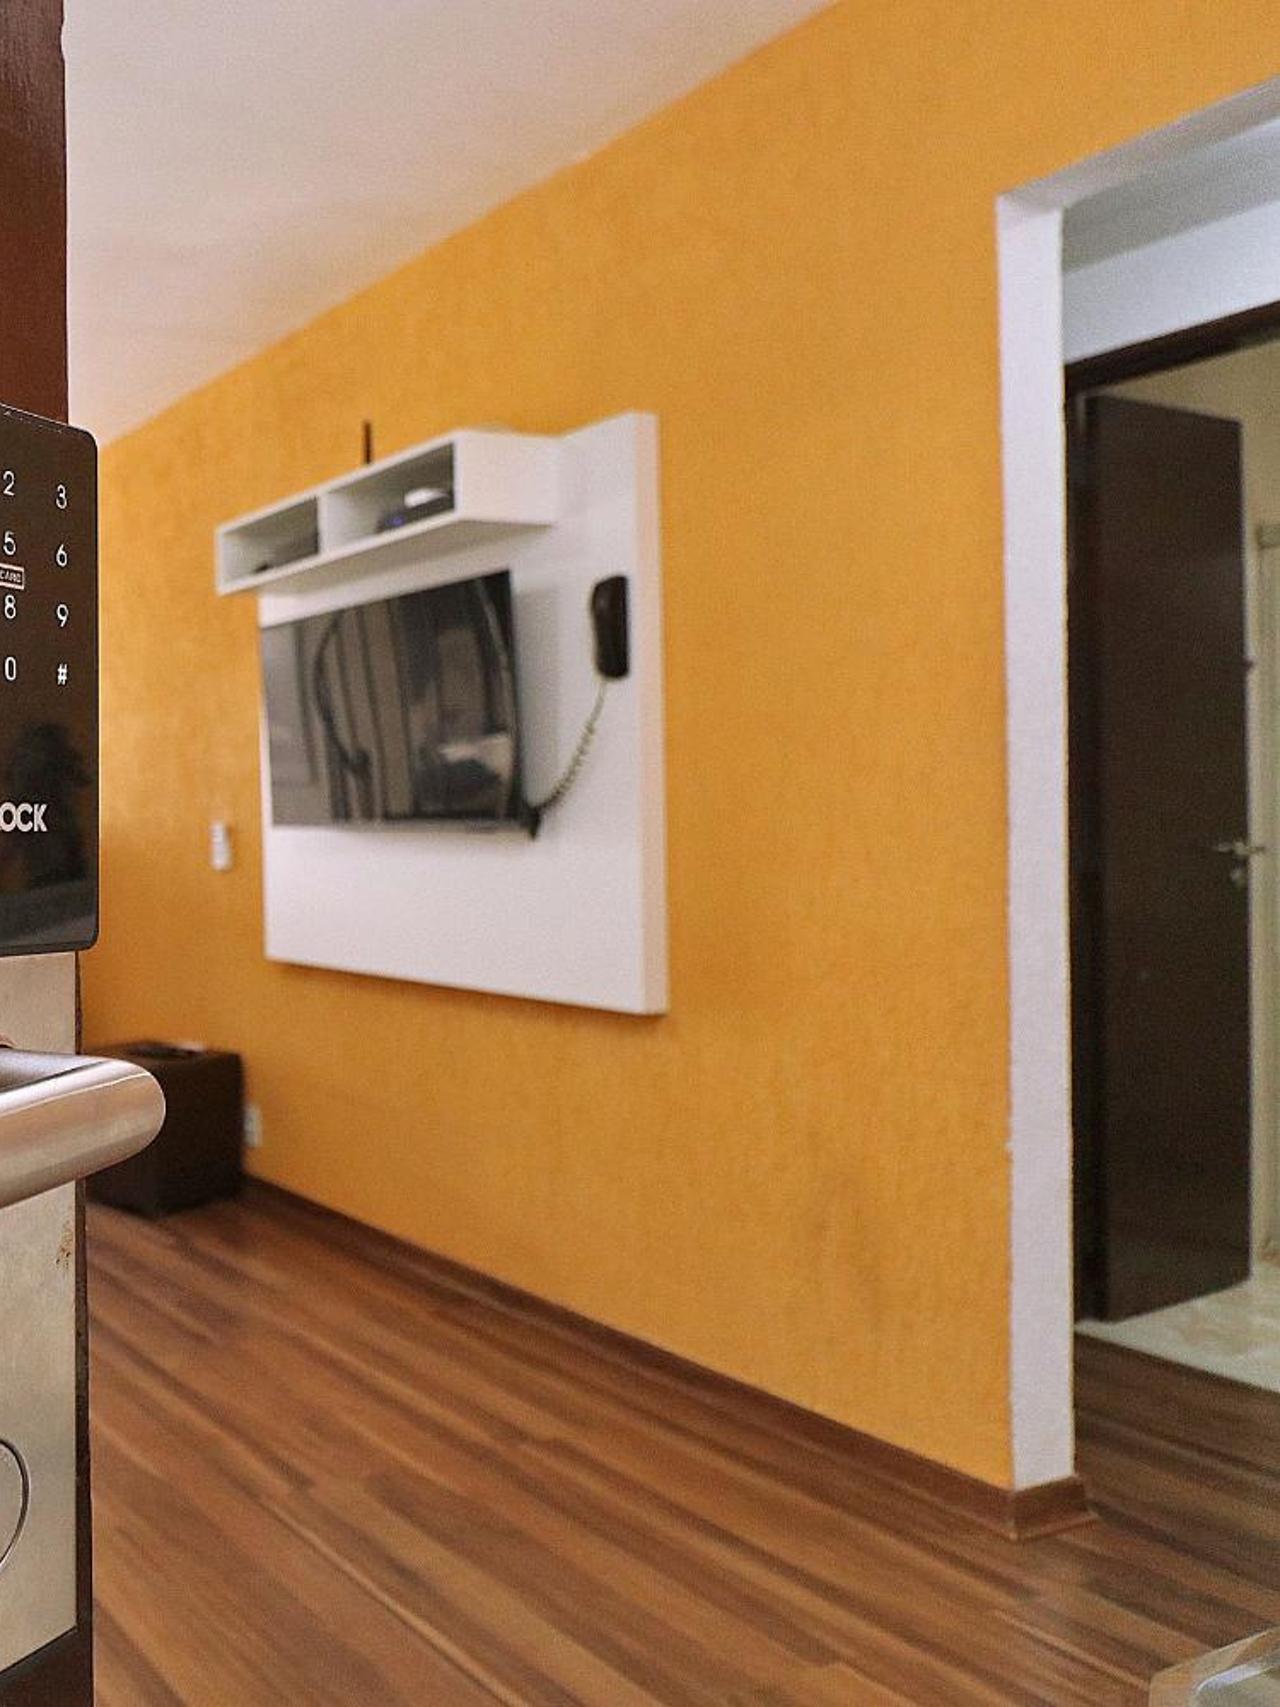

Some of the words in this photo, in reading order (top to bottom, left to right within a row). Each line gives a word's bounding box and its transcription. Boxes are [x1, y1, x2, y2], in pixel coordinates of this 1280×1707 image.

[2, 470, 16, 497] 2
[55, 483, 68, 509] 3
[2, 530, 17, 556] 5
[55, 543, 68, 567] 6
[3, 594, 17, 620] 8
[56, 603, 69, 628] 9
[4, 656, 17, 682] 0
